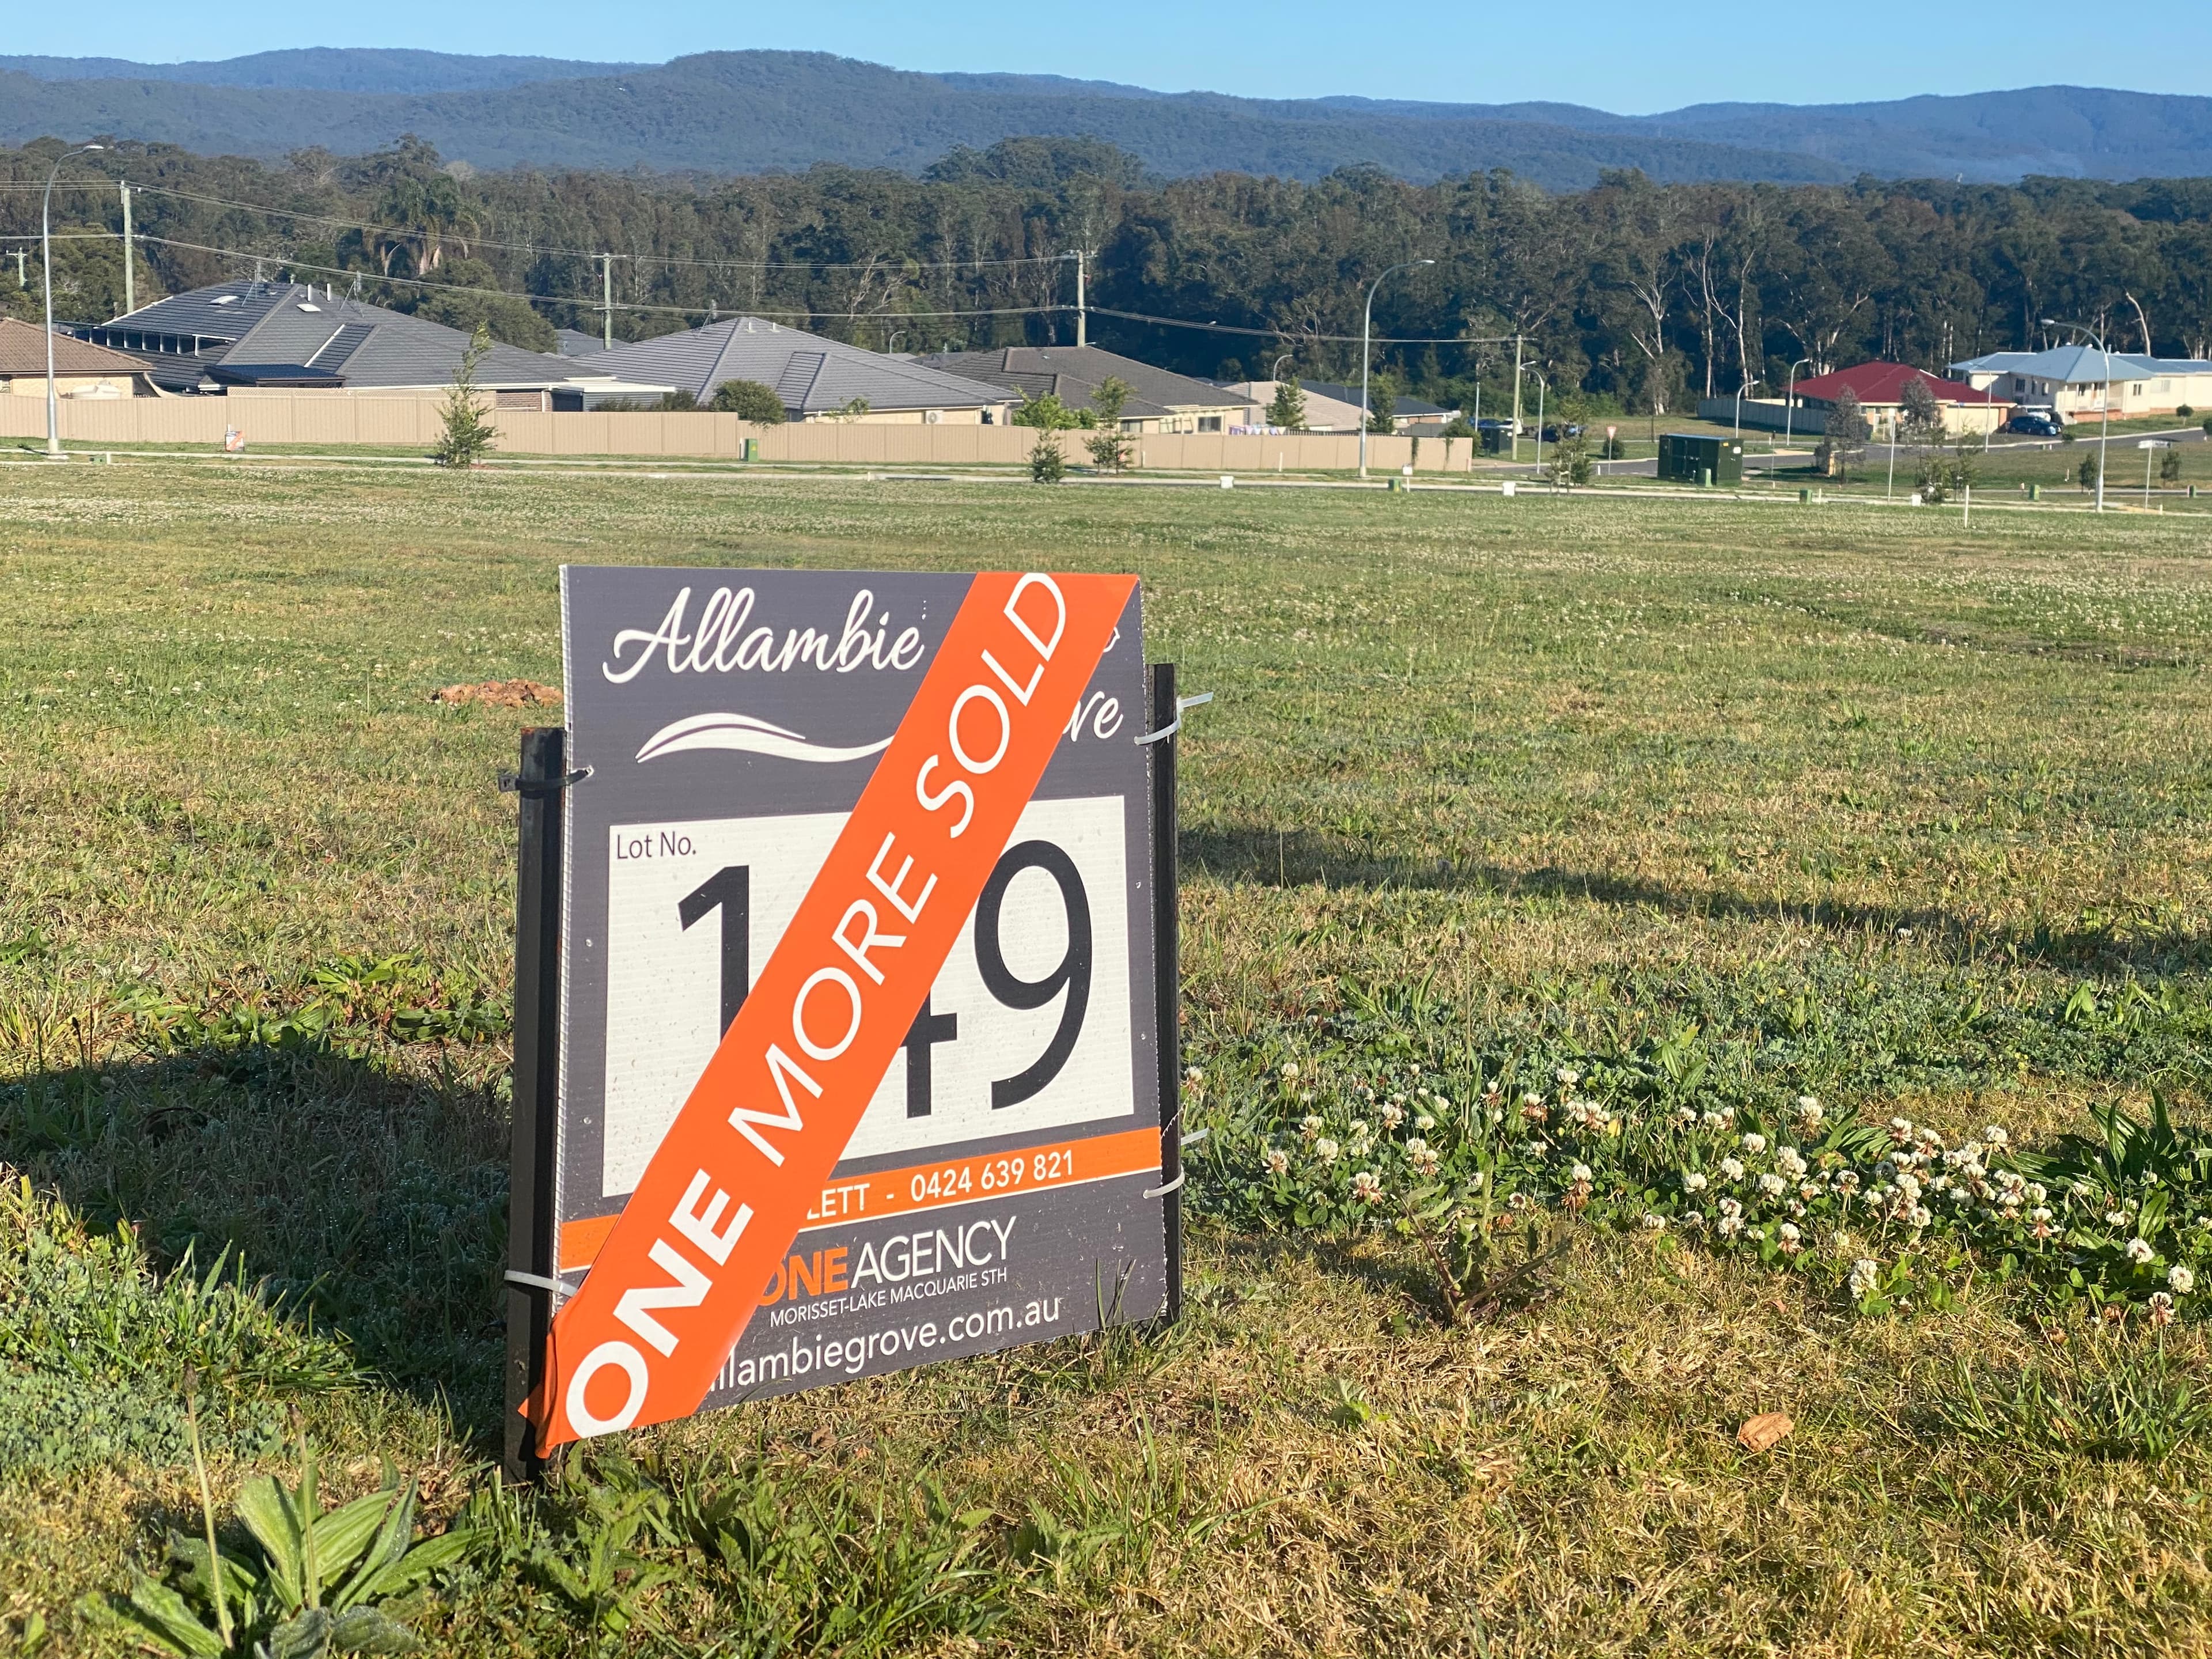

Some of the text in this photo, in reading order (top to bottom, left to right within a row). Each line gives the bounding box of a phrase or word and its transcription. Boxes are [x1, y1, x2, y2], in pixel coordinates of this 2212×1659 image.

[601, 586, 925, 683] Allambie
[617, 831, 696, 859] Lot No.
[566, 573, 1066, 1438] ONE MORE SOLD
[911, 1166, 972, 1202] 0424
[981, 1158, 1024, 1190] 639
[1033, 1150, 1072, 1181] 821
[770, 1267, 1007, 1327] MORISSET-LAKE MACQUARIE STH
[711, 1298, 1059, 1390] lambiegrove.com.au
